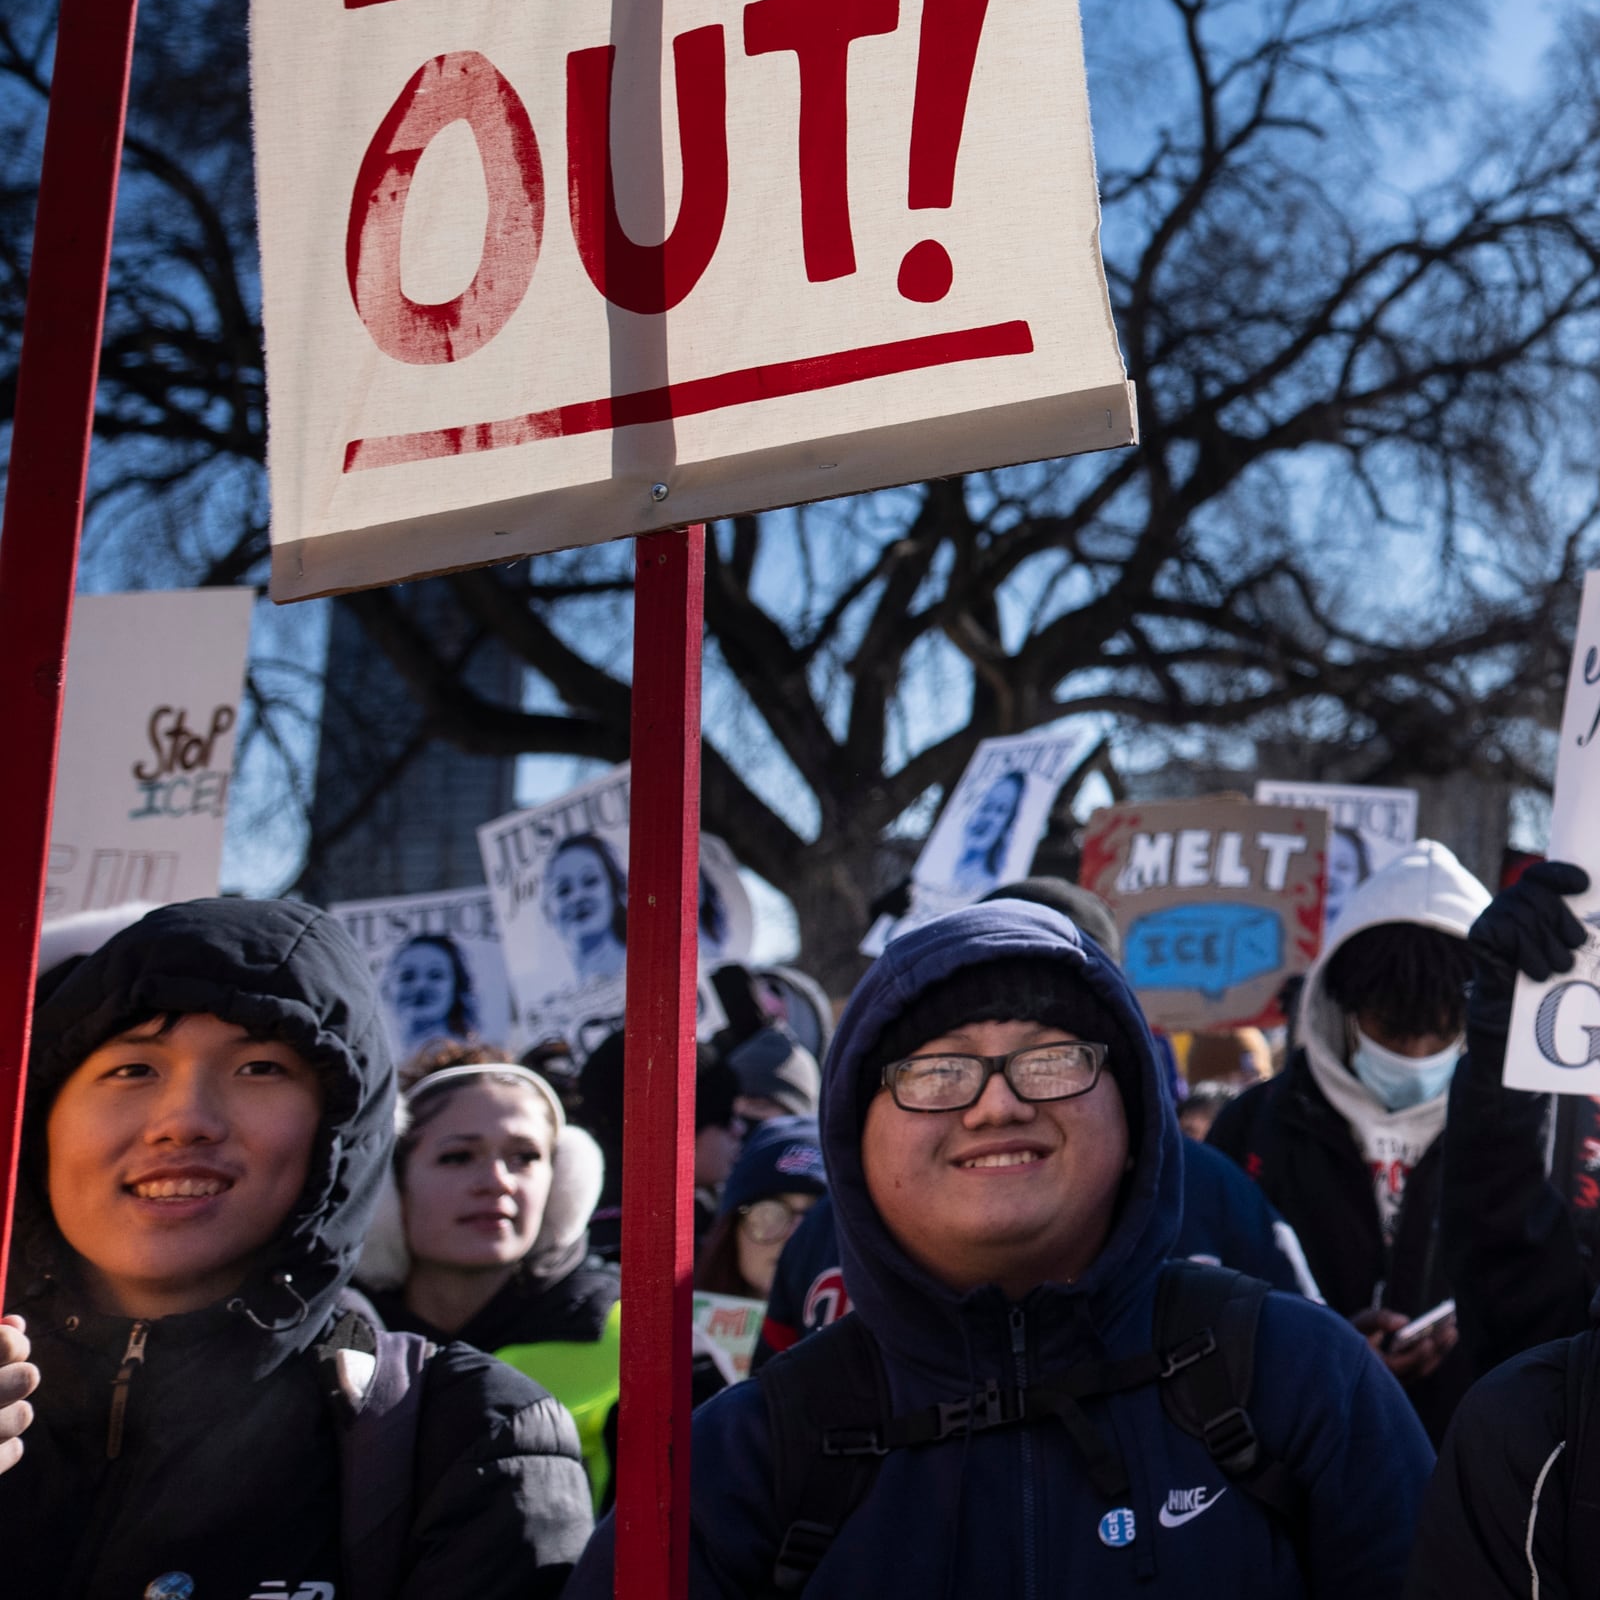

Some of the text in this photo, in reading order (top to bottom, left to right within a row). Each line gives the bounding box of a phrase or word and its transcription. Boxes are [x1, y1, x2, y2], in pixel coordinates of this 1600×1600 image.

[1116, 828, 1307, 894] MELT
[1141, 933, 1220, 968] ICE
[1168, 1486, 1207, 1512] NIKE
